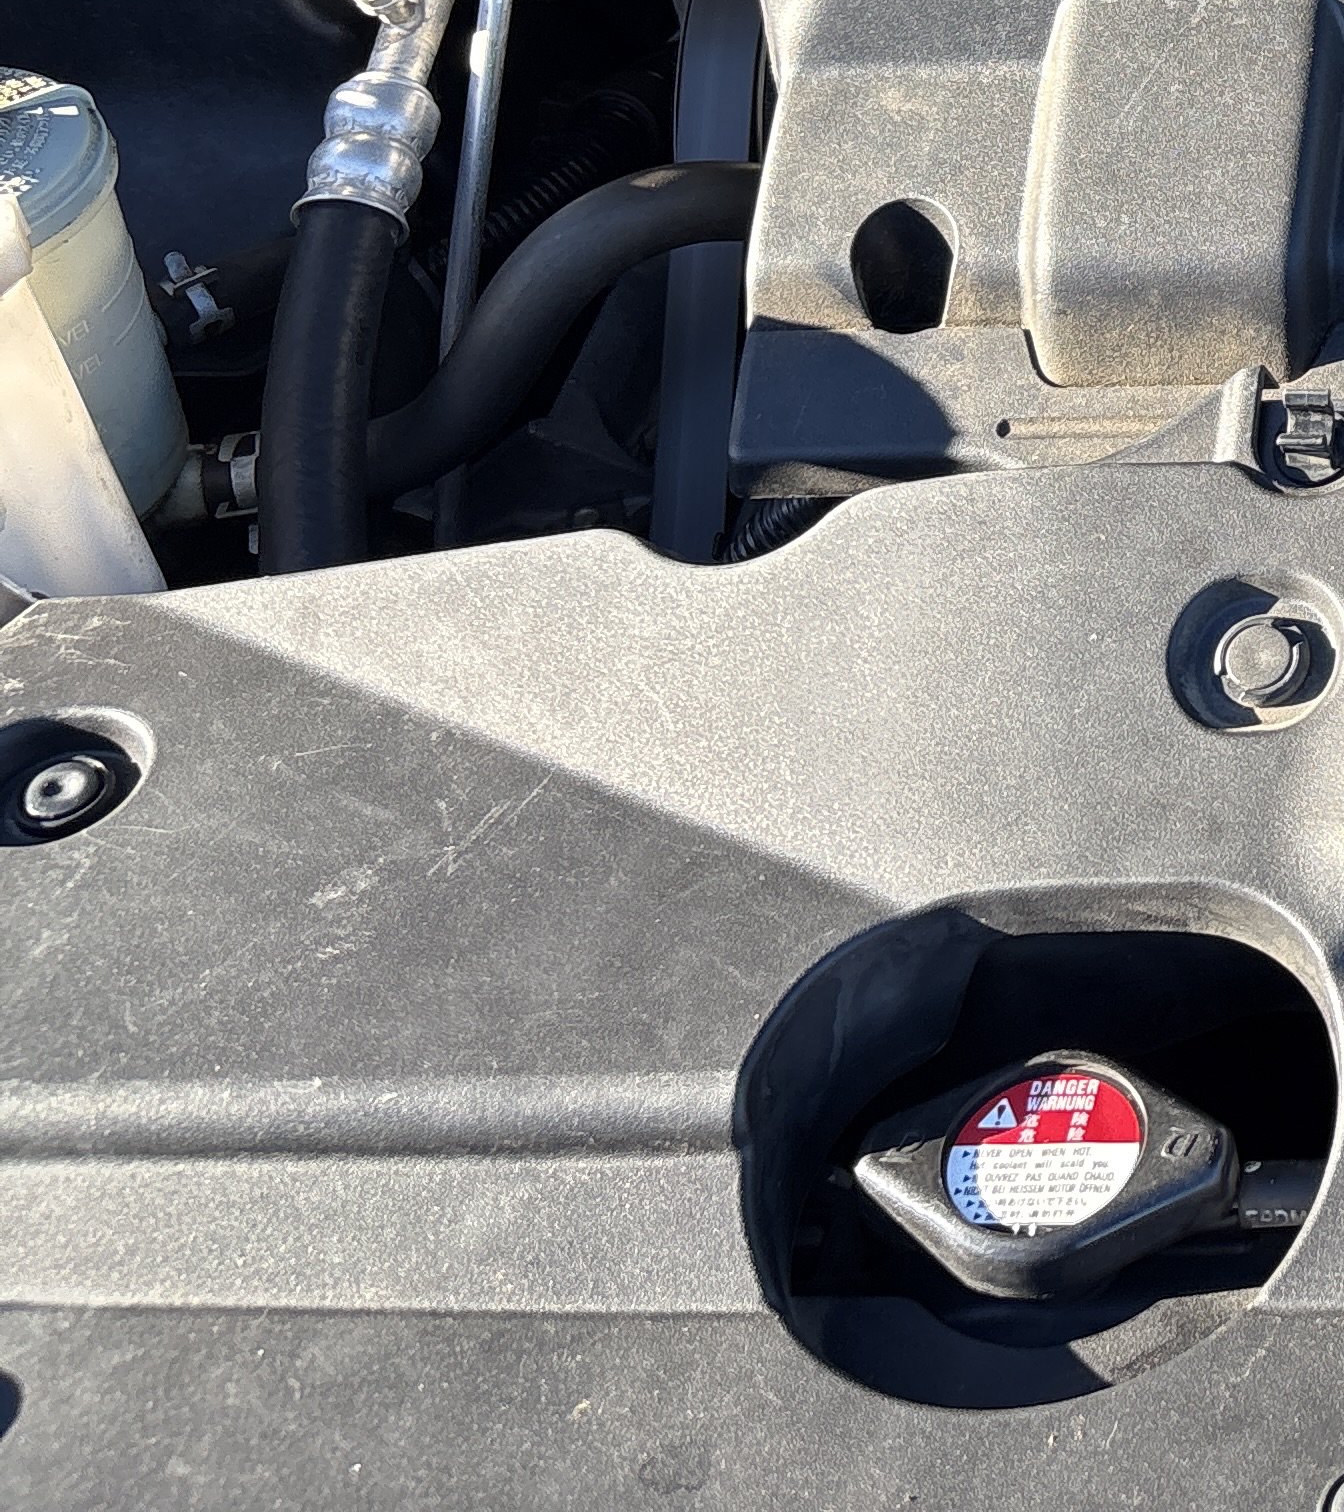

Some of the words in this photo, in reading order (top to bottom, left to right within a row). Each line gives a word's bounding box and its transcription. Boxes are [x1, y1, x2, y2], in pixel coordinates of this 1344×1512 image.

[1029, 1079, 1100, 1095] DANGER
[1026, 1095, 1096, 1111] WARNUNG
[1009, 1148, 1032, 1158] OPEN
[1041, 1147, 1066, 1157] WHEN
[993, 1159, 1027, 1169] coolant
[1025, 1172, 1042, 1182] PAS
[963, 1185, 989, 1196] NICT
